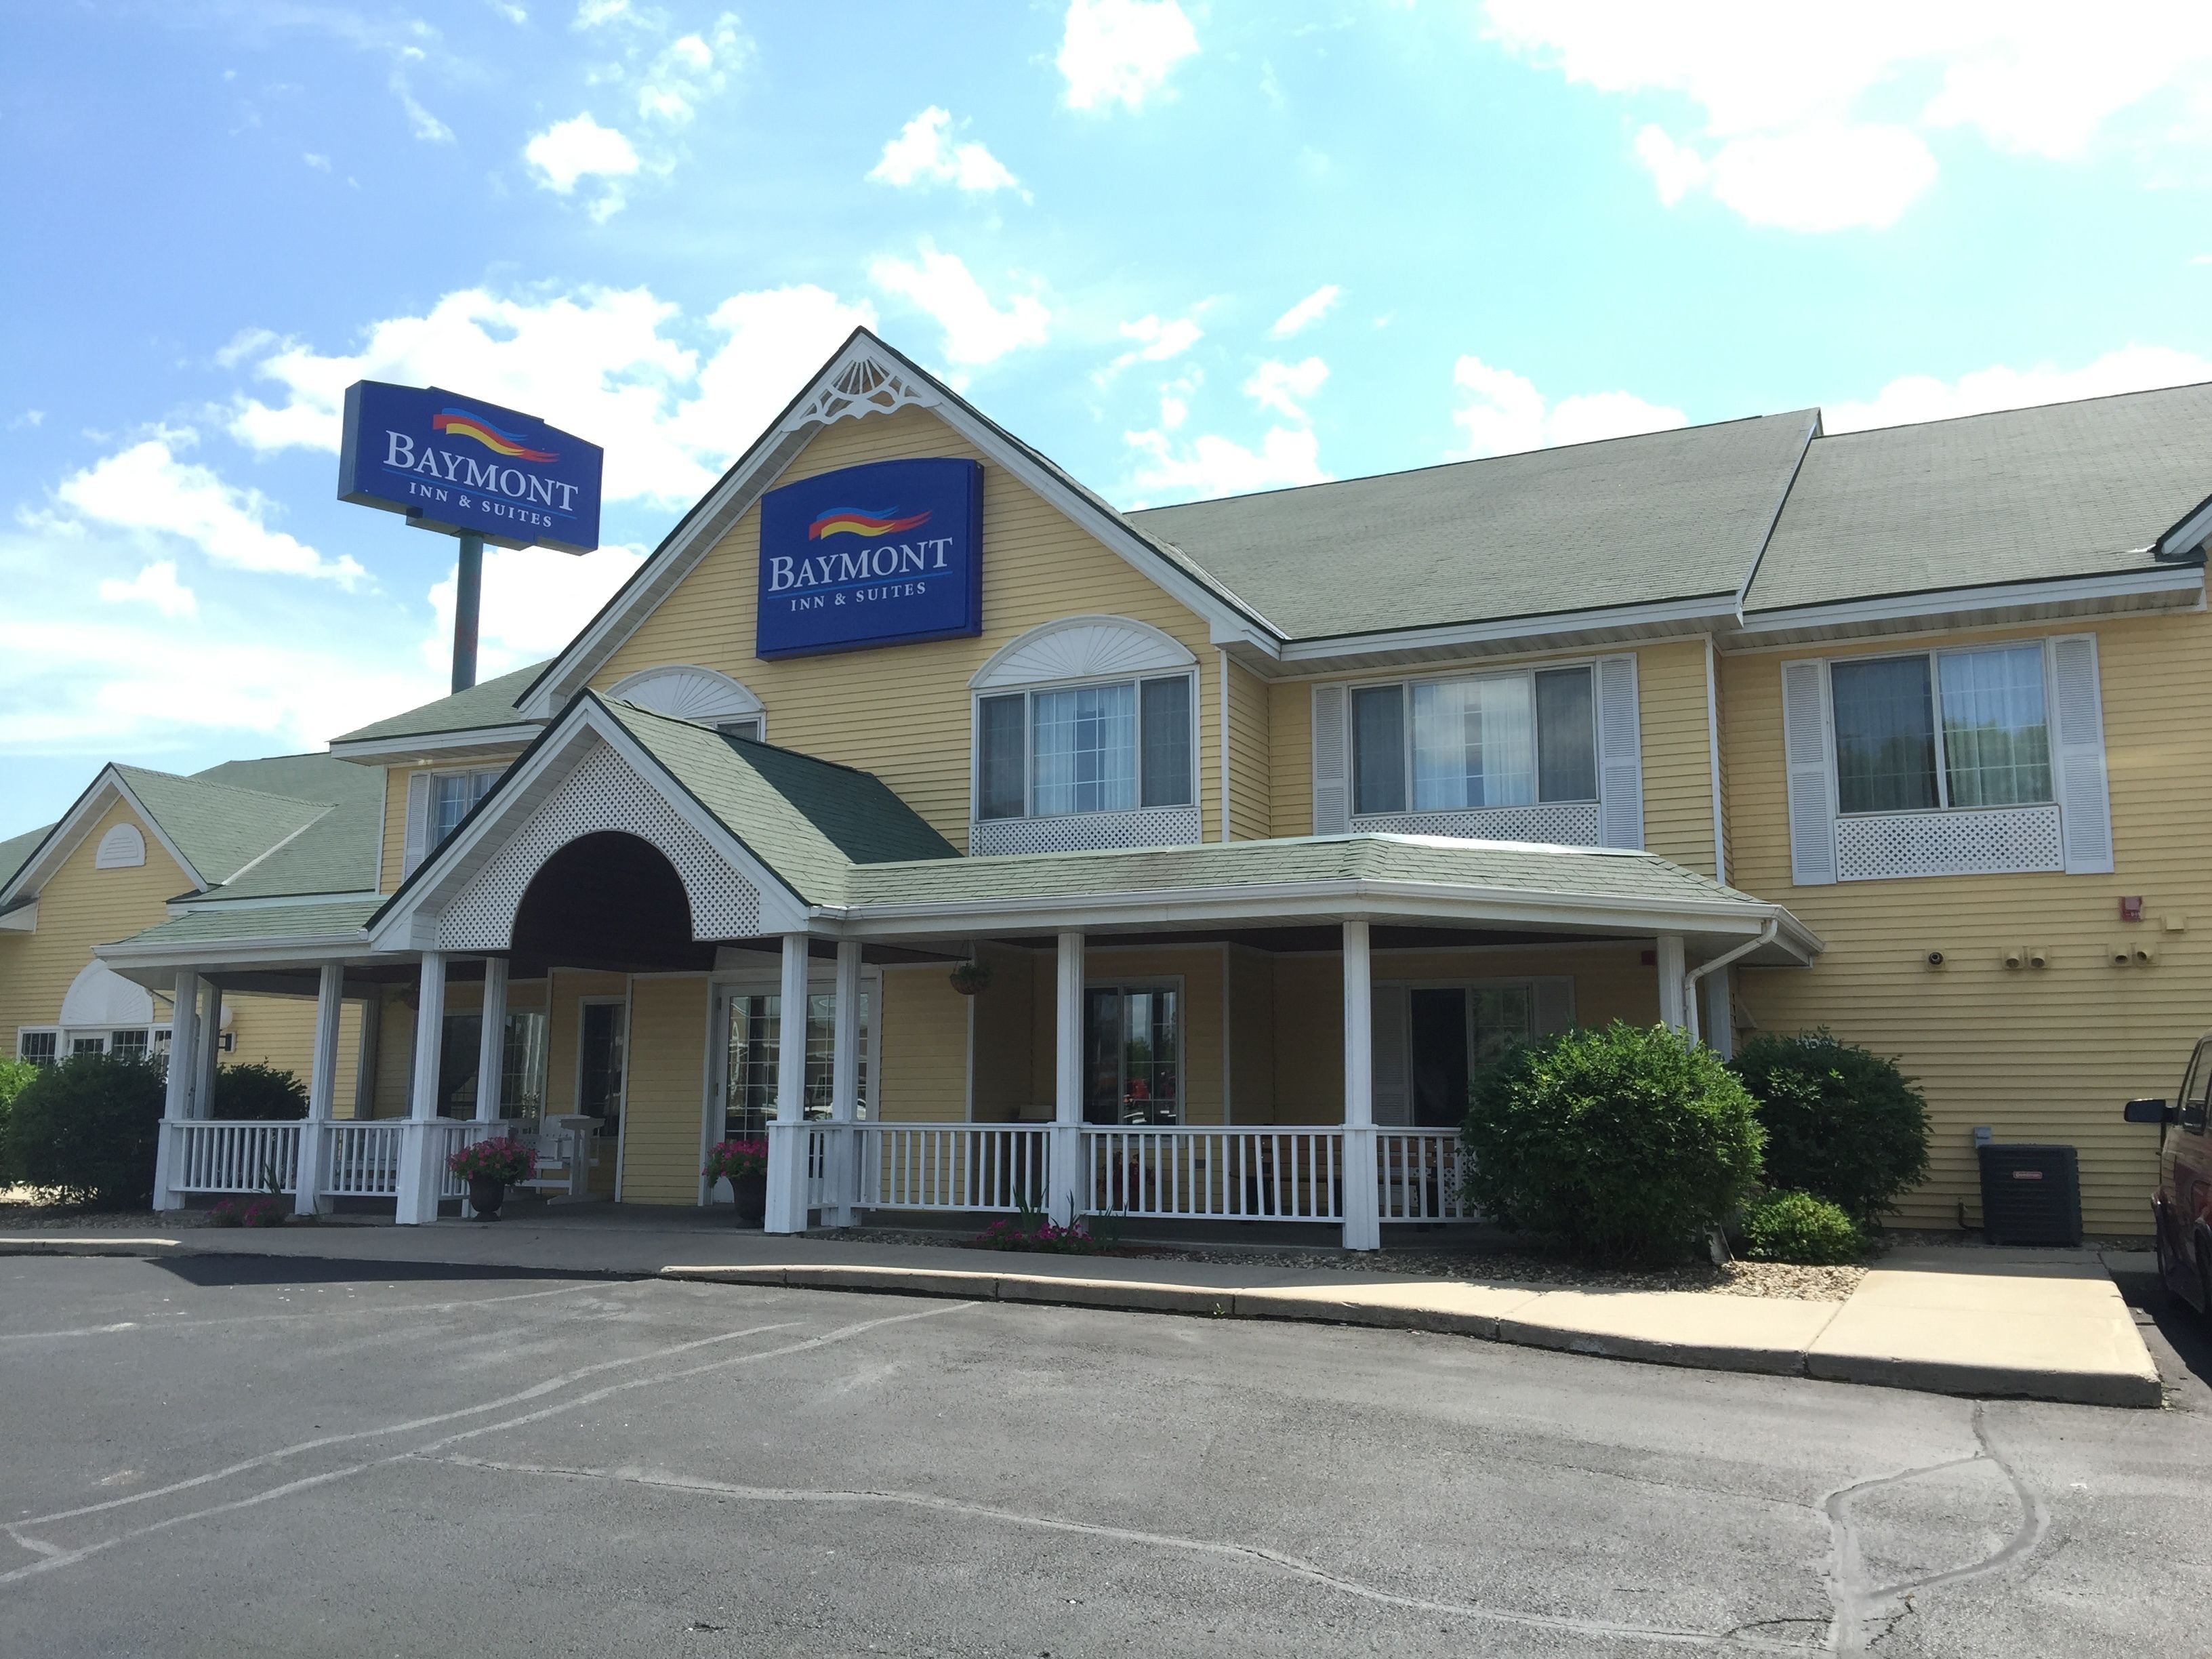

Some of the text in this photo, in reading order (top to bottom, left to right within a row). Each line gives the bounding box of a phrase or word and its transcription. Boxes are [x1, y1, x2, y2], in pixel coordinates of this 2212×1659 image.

[384, 430, 579, 511] BAYMONT
[409, 482, 552, 527] INN & SUITES
[768, 537, 953, 592] BAYMONT
[791, 582, 926, 611] INN & SUITES
